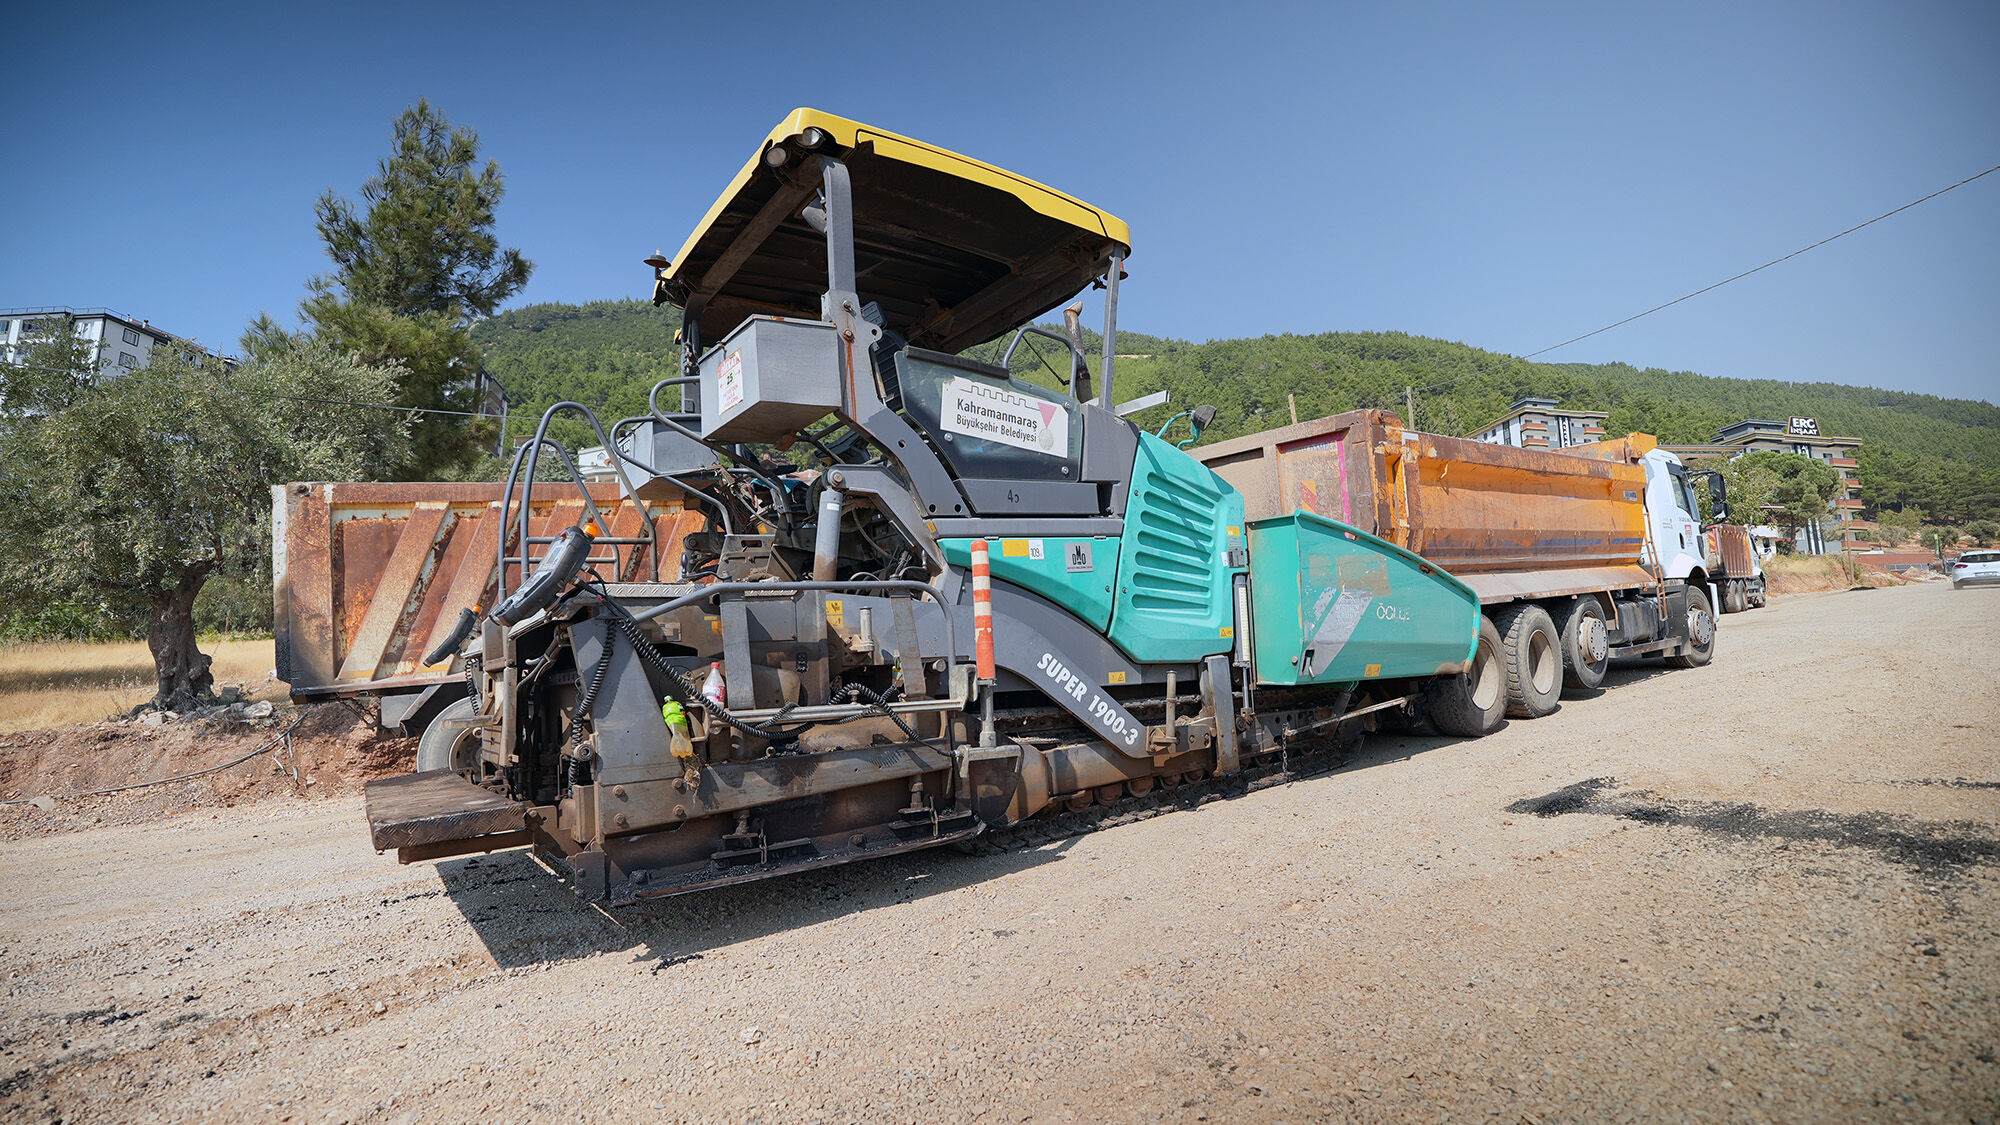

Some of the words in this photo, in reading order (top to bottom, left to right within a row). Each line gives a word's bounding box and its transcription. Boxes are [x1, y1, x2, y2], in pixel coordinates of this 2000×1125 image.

[956, 414, 999, 433] Büyükşehir
[1000, 424, 1037, 443] Belediyesi
[957, 398, 1038, 432] Kahramanmaraş
[1792, 417, 1816, 429] ERC
[1036, 652, 1088, 703] SUPER
[1087, 694, 1139, 745] 1900-3
